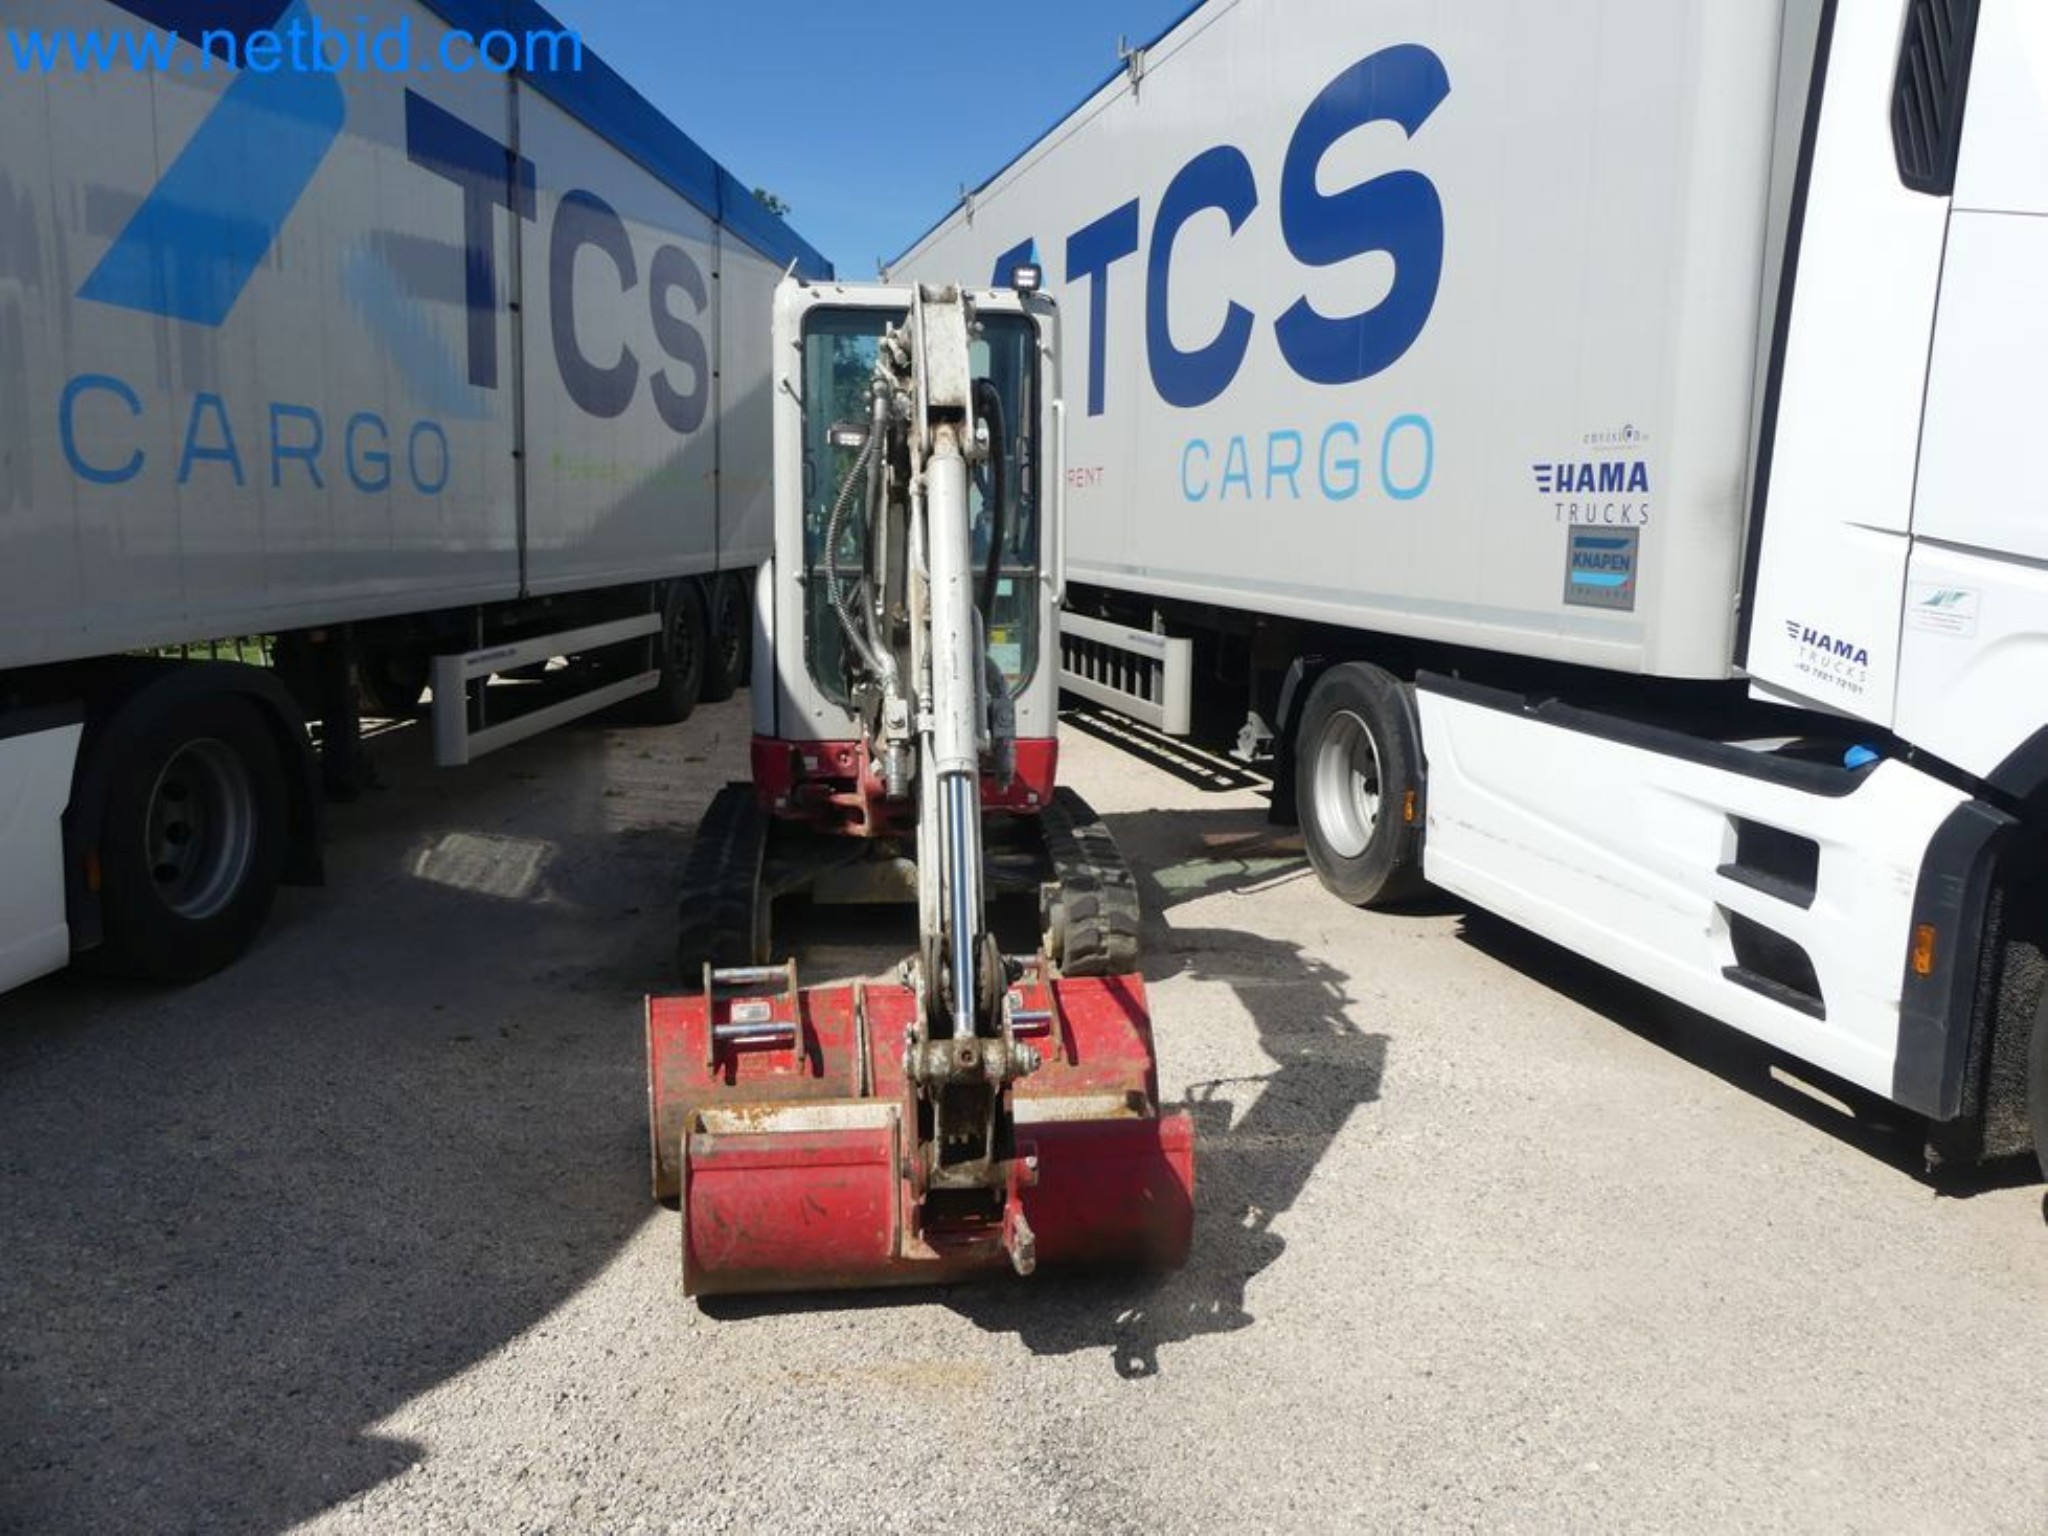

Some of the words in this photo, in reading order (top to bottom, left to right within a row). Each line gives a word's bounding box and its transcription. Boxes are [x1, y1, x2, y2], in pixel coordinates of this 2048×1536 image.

[58, 373, 451, 495] CARGO
[1181, 414, 1435, 502] CARGO
[1555, 461, 1649, 493] HAMA
[1555, 503, 1649, 525] TRUCKS
[1571, 550, 1631, 571] KNAPEN
[1799, 645, 1867, 683] TRUCKS
[1802, 627, 1868, 668] HAMA
